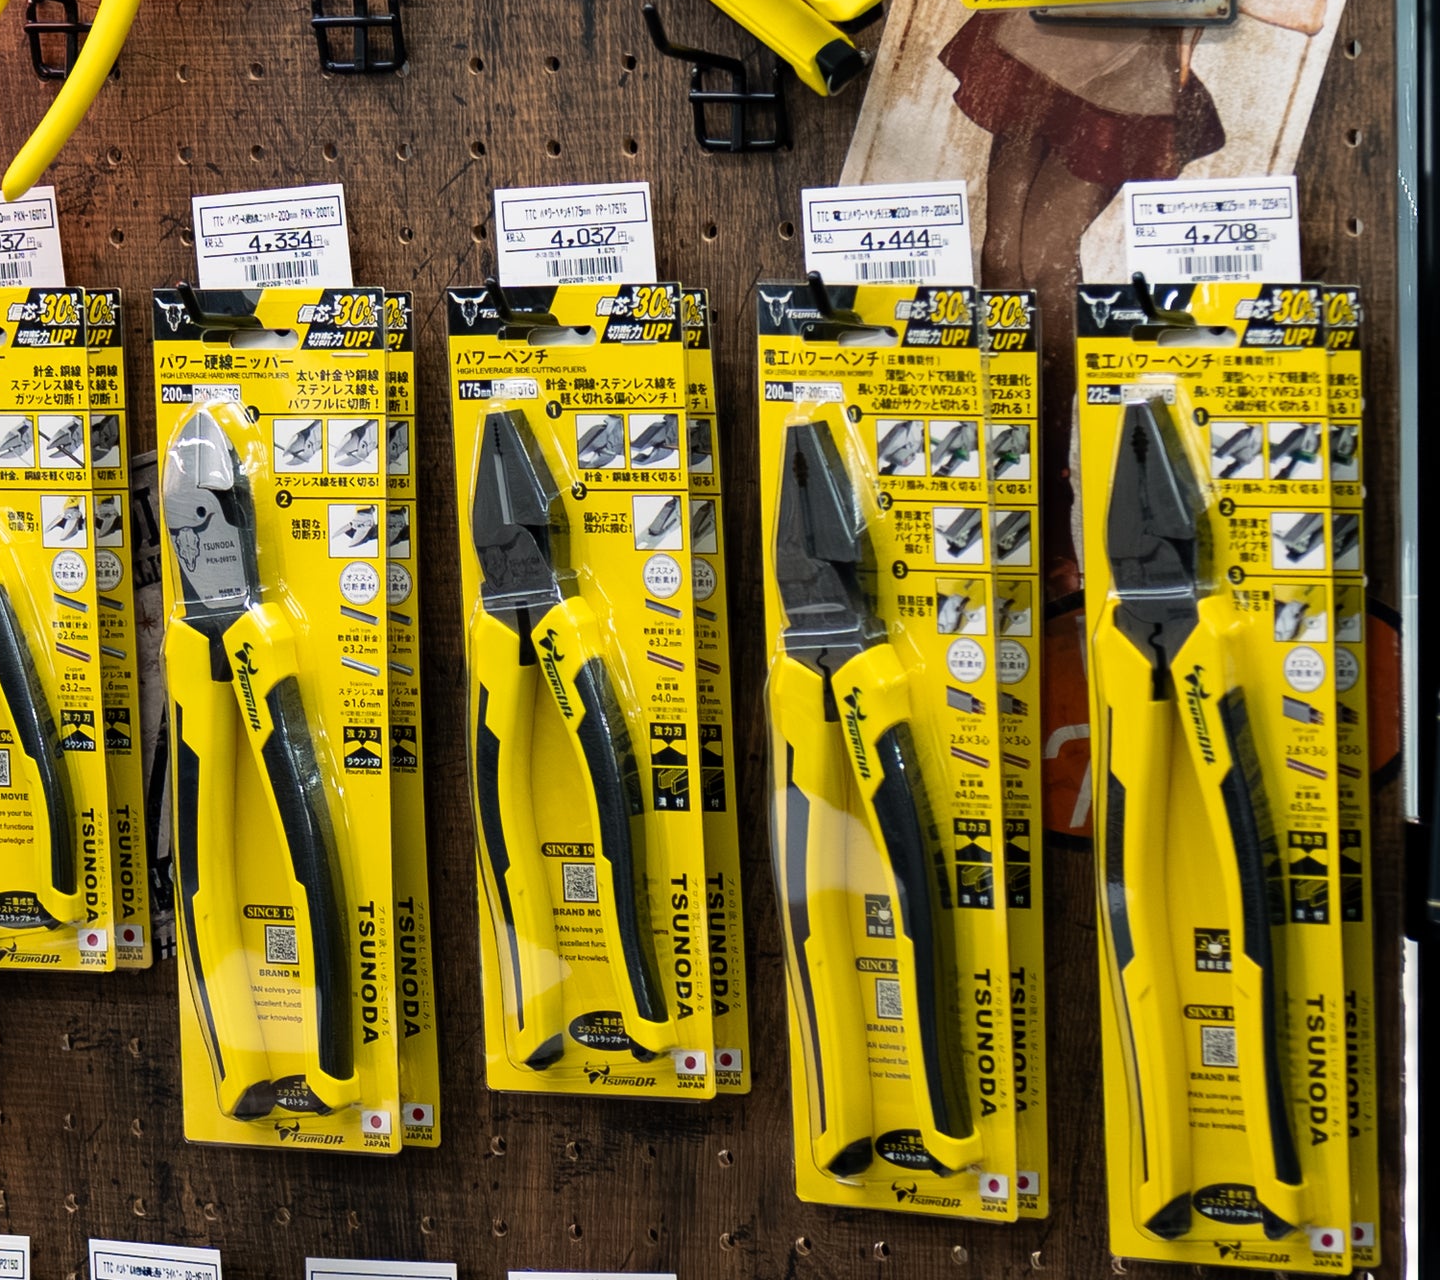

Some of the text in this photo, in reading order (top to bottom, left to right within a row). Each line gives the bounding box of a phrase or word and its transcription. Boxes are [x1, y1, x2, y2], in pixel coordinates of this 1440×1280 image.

[159, 354, 295, 371] パワー硬線ニッパー
[456, 349, 549, 365] パワーペンチ
[763, 349, 879, 366] 電工パワーペンチ
[1085, 353, 1216, 370] 電工パワーペンチ
[296, 369, 379, 382] 太い針金や銅線
[296, 384, 379, 396] ステンレス線も
[0, 792, 29, 801] MOVIE
[116, 804, 133, 920] TSUNODA
[670, 872, 691, 1020] TSUNODA
[359, 900, 379, 1045] TSUNODA
[397, 896, 420, 1039] TSUNODA
[973, 968, 997, 1118] TSUNODA
[1306, 993, 1328, 1148] TSUNODA
